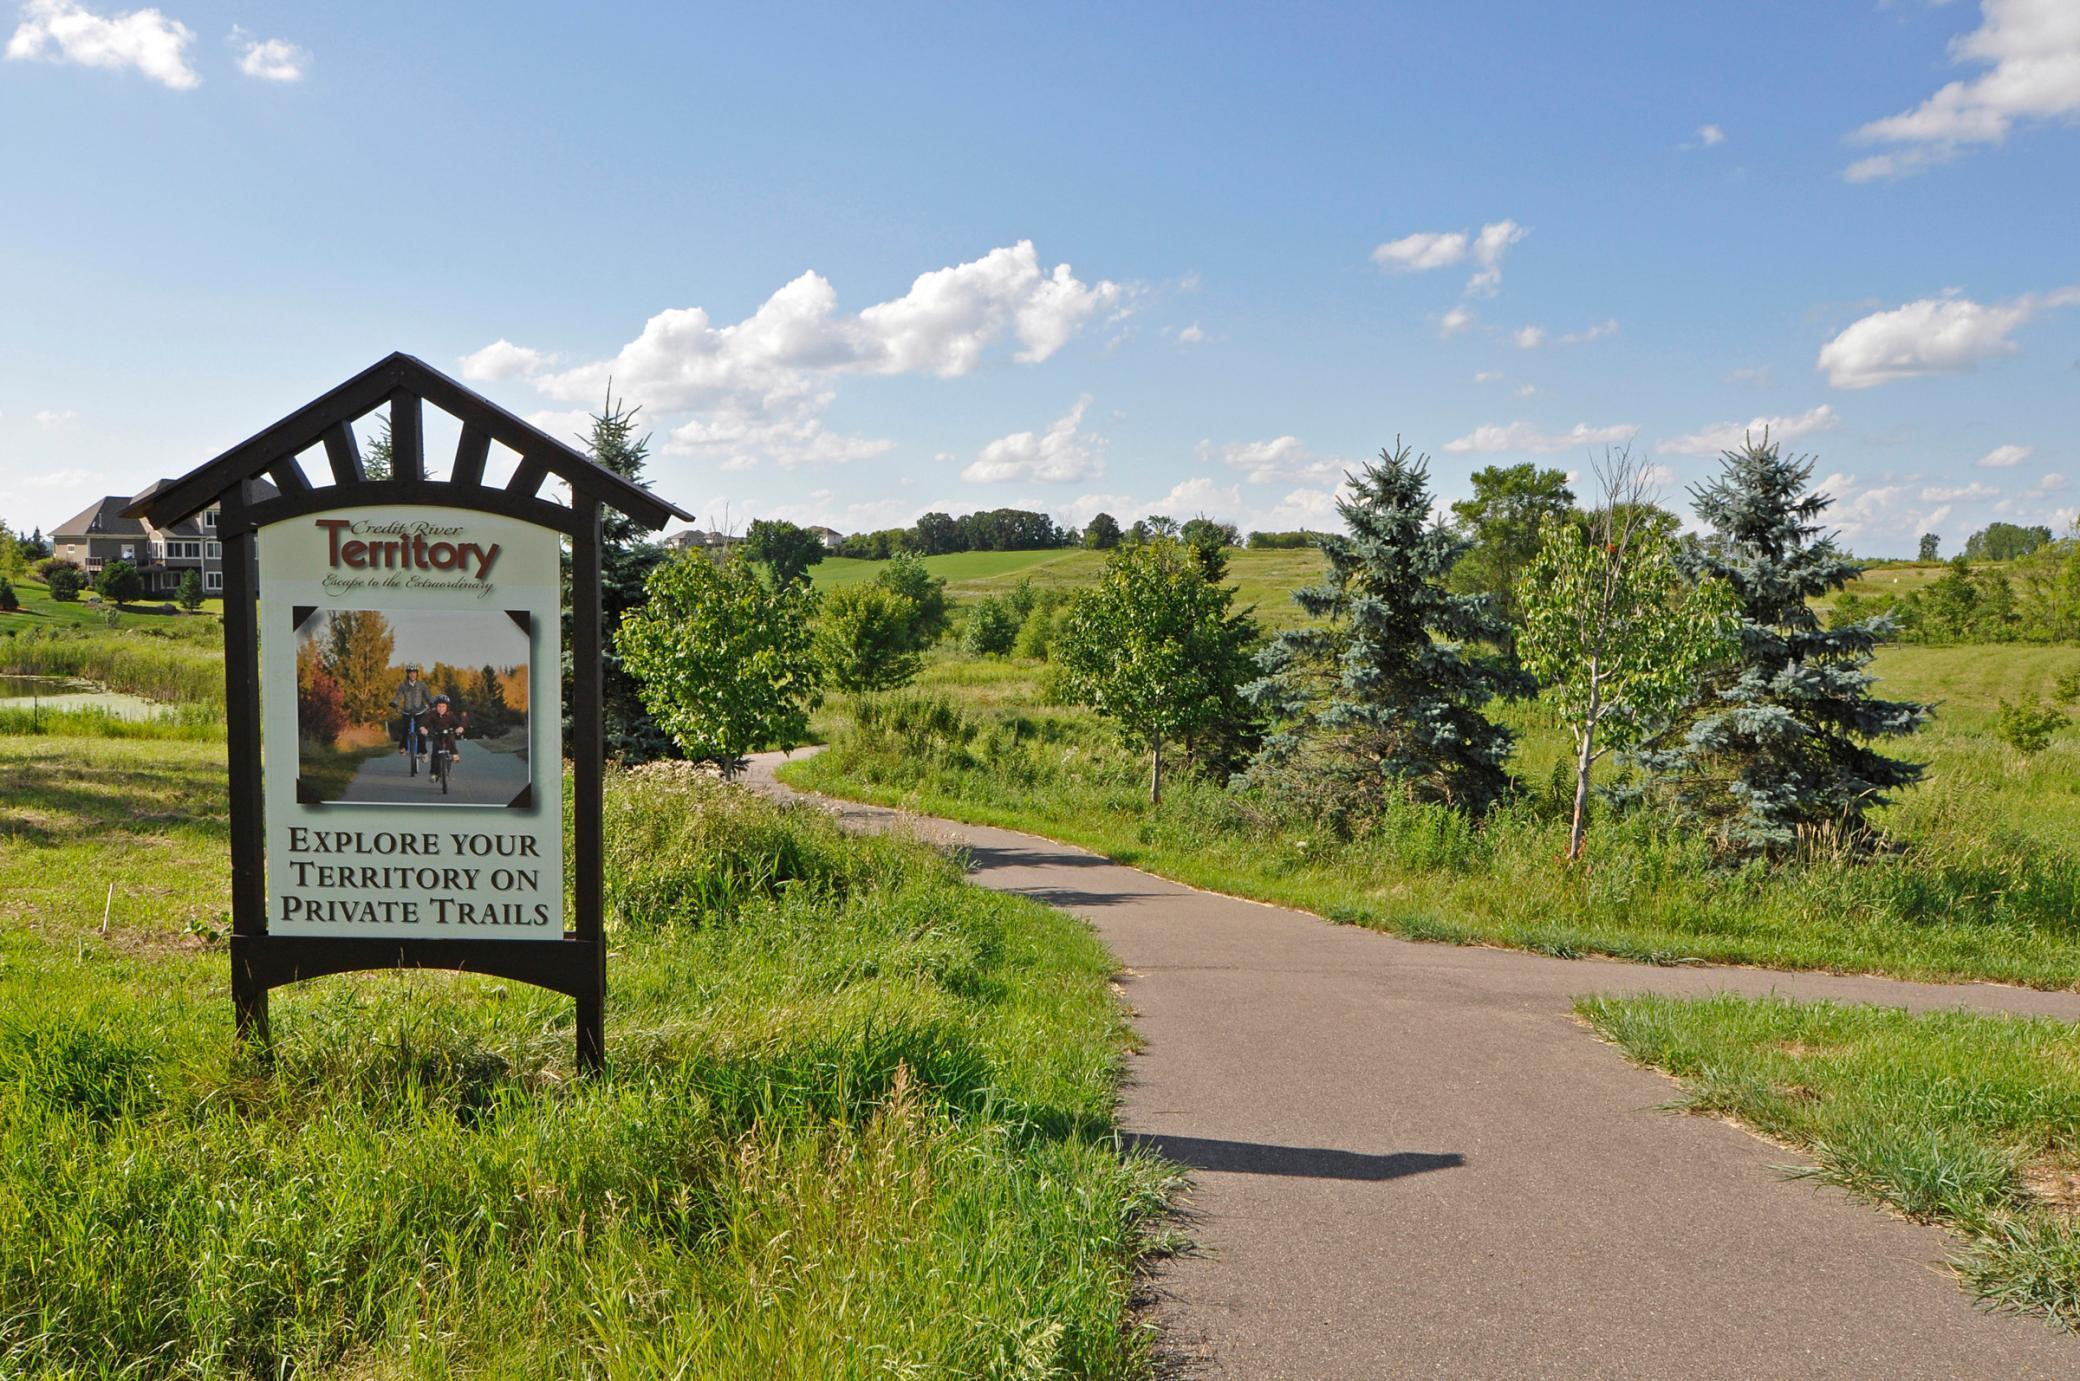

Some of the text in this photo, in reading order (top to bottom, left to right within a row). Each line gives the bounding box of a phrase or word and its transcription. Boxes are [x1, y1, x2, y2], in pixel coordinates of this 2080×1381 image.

[351, 520, 463, 536] Credit River
[315, 519, 500, 579] Territory
[322, 572, 494, 599] Escape to the Extraordinary
[288, 827, 540, 857] EXPLORE YOUR
[289, 860, 538, 891] TERRITORY ON
[280, 895, 549, 926] PRIVATE TRAILS
